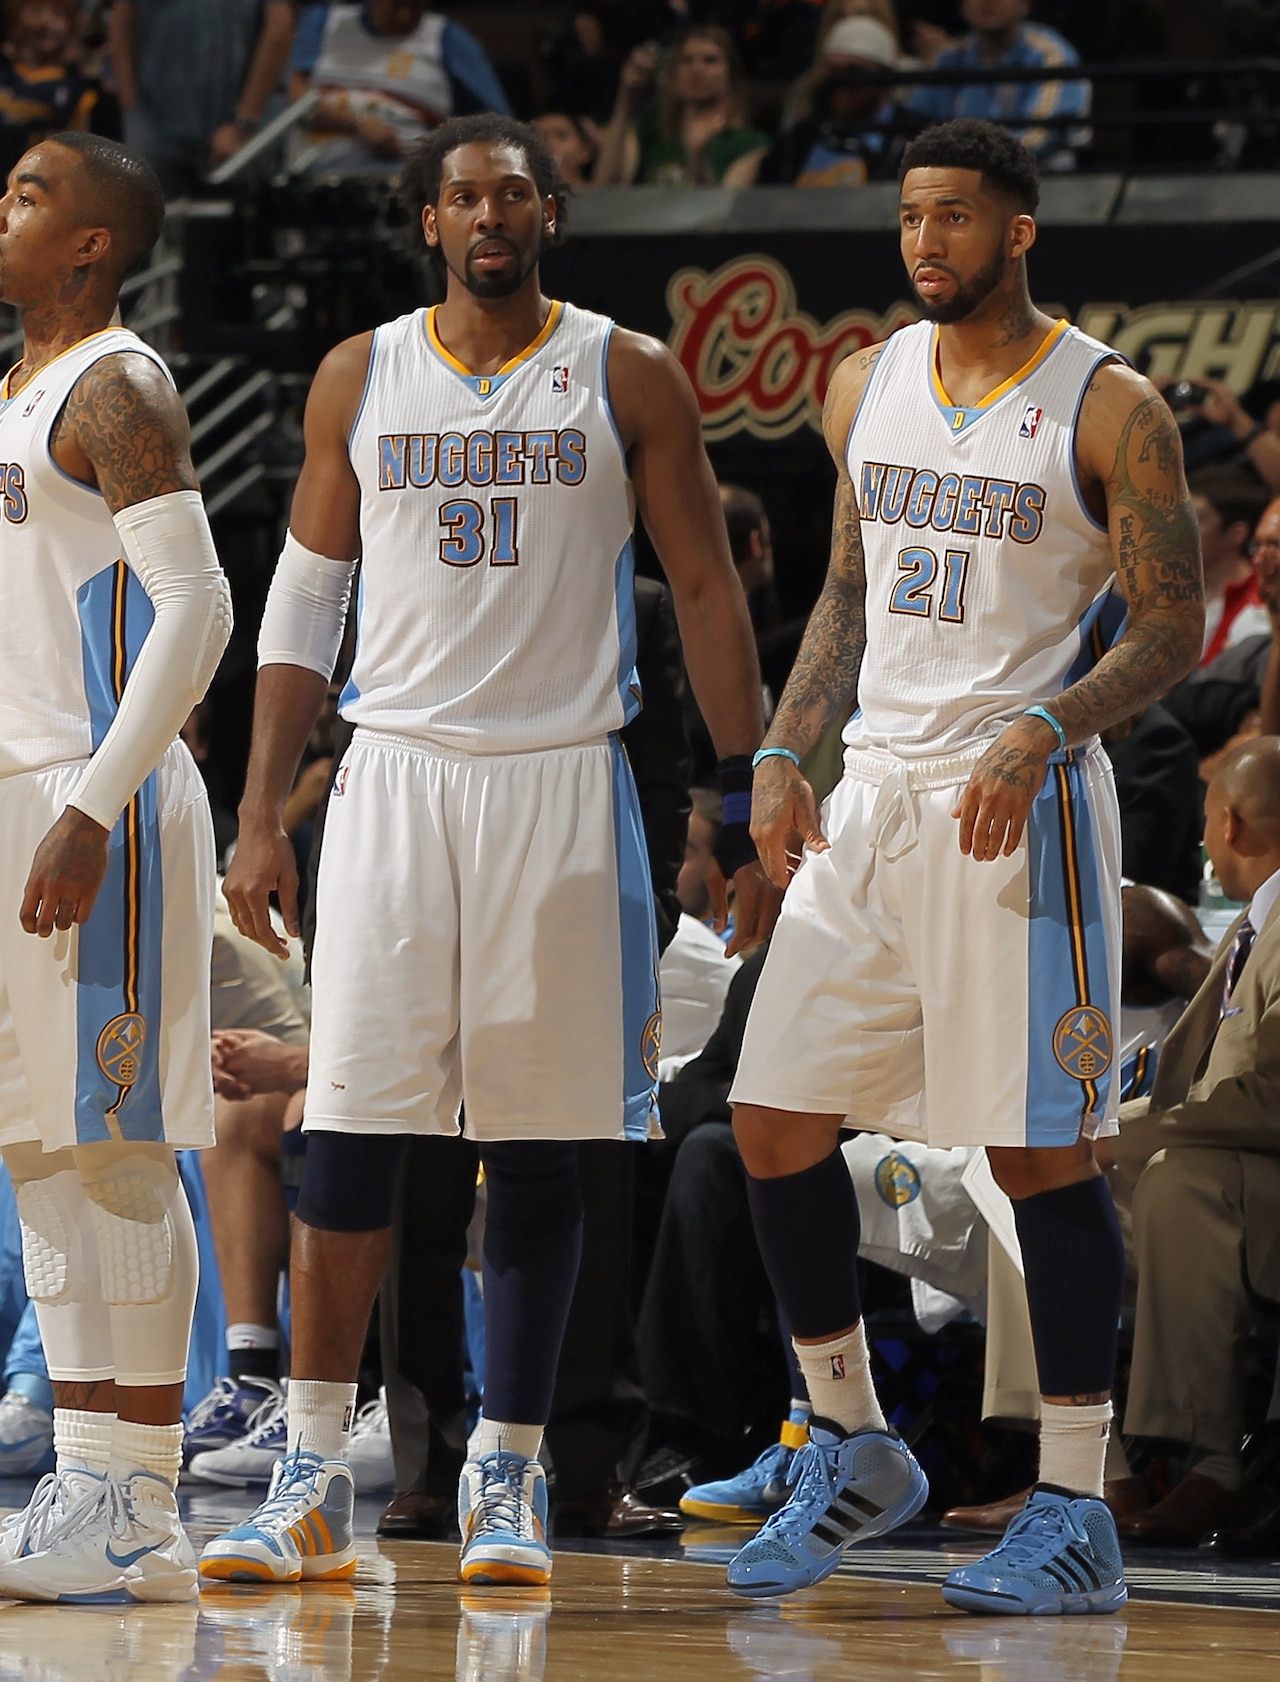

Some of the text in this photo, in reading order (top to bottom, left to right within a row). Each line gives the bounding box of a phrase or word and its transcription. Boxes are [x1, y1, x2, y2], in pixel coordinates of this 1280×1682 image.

[666, 253, 918, 442] Coo
[378, 429, 587, 492] NUGGETS
[439, 497, 519, 567] 31
[859, 461, 1047, 543] NUGGETS
[888, 546, 970, 623] 21
